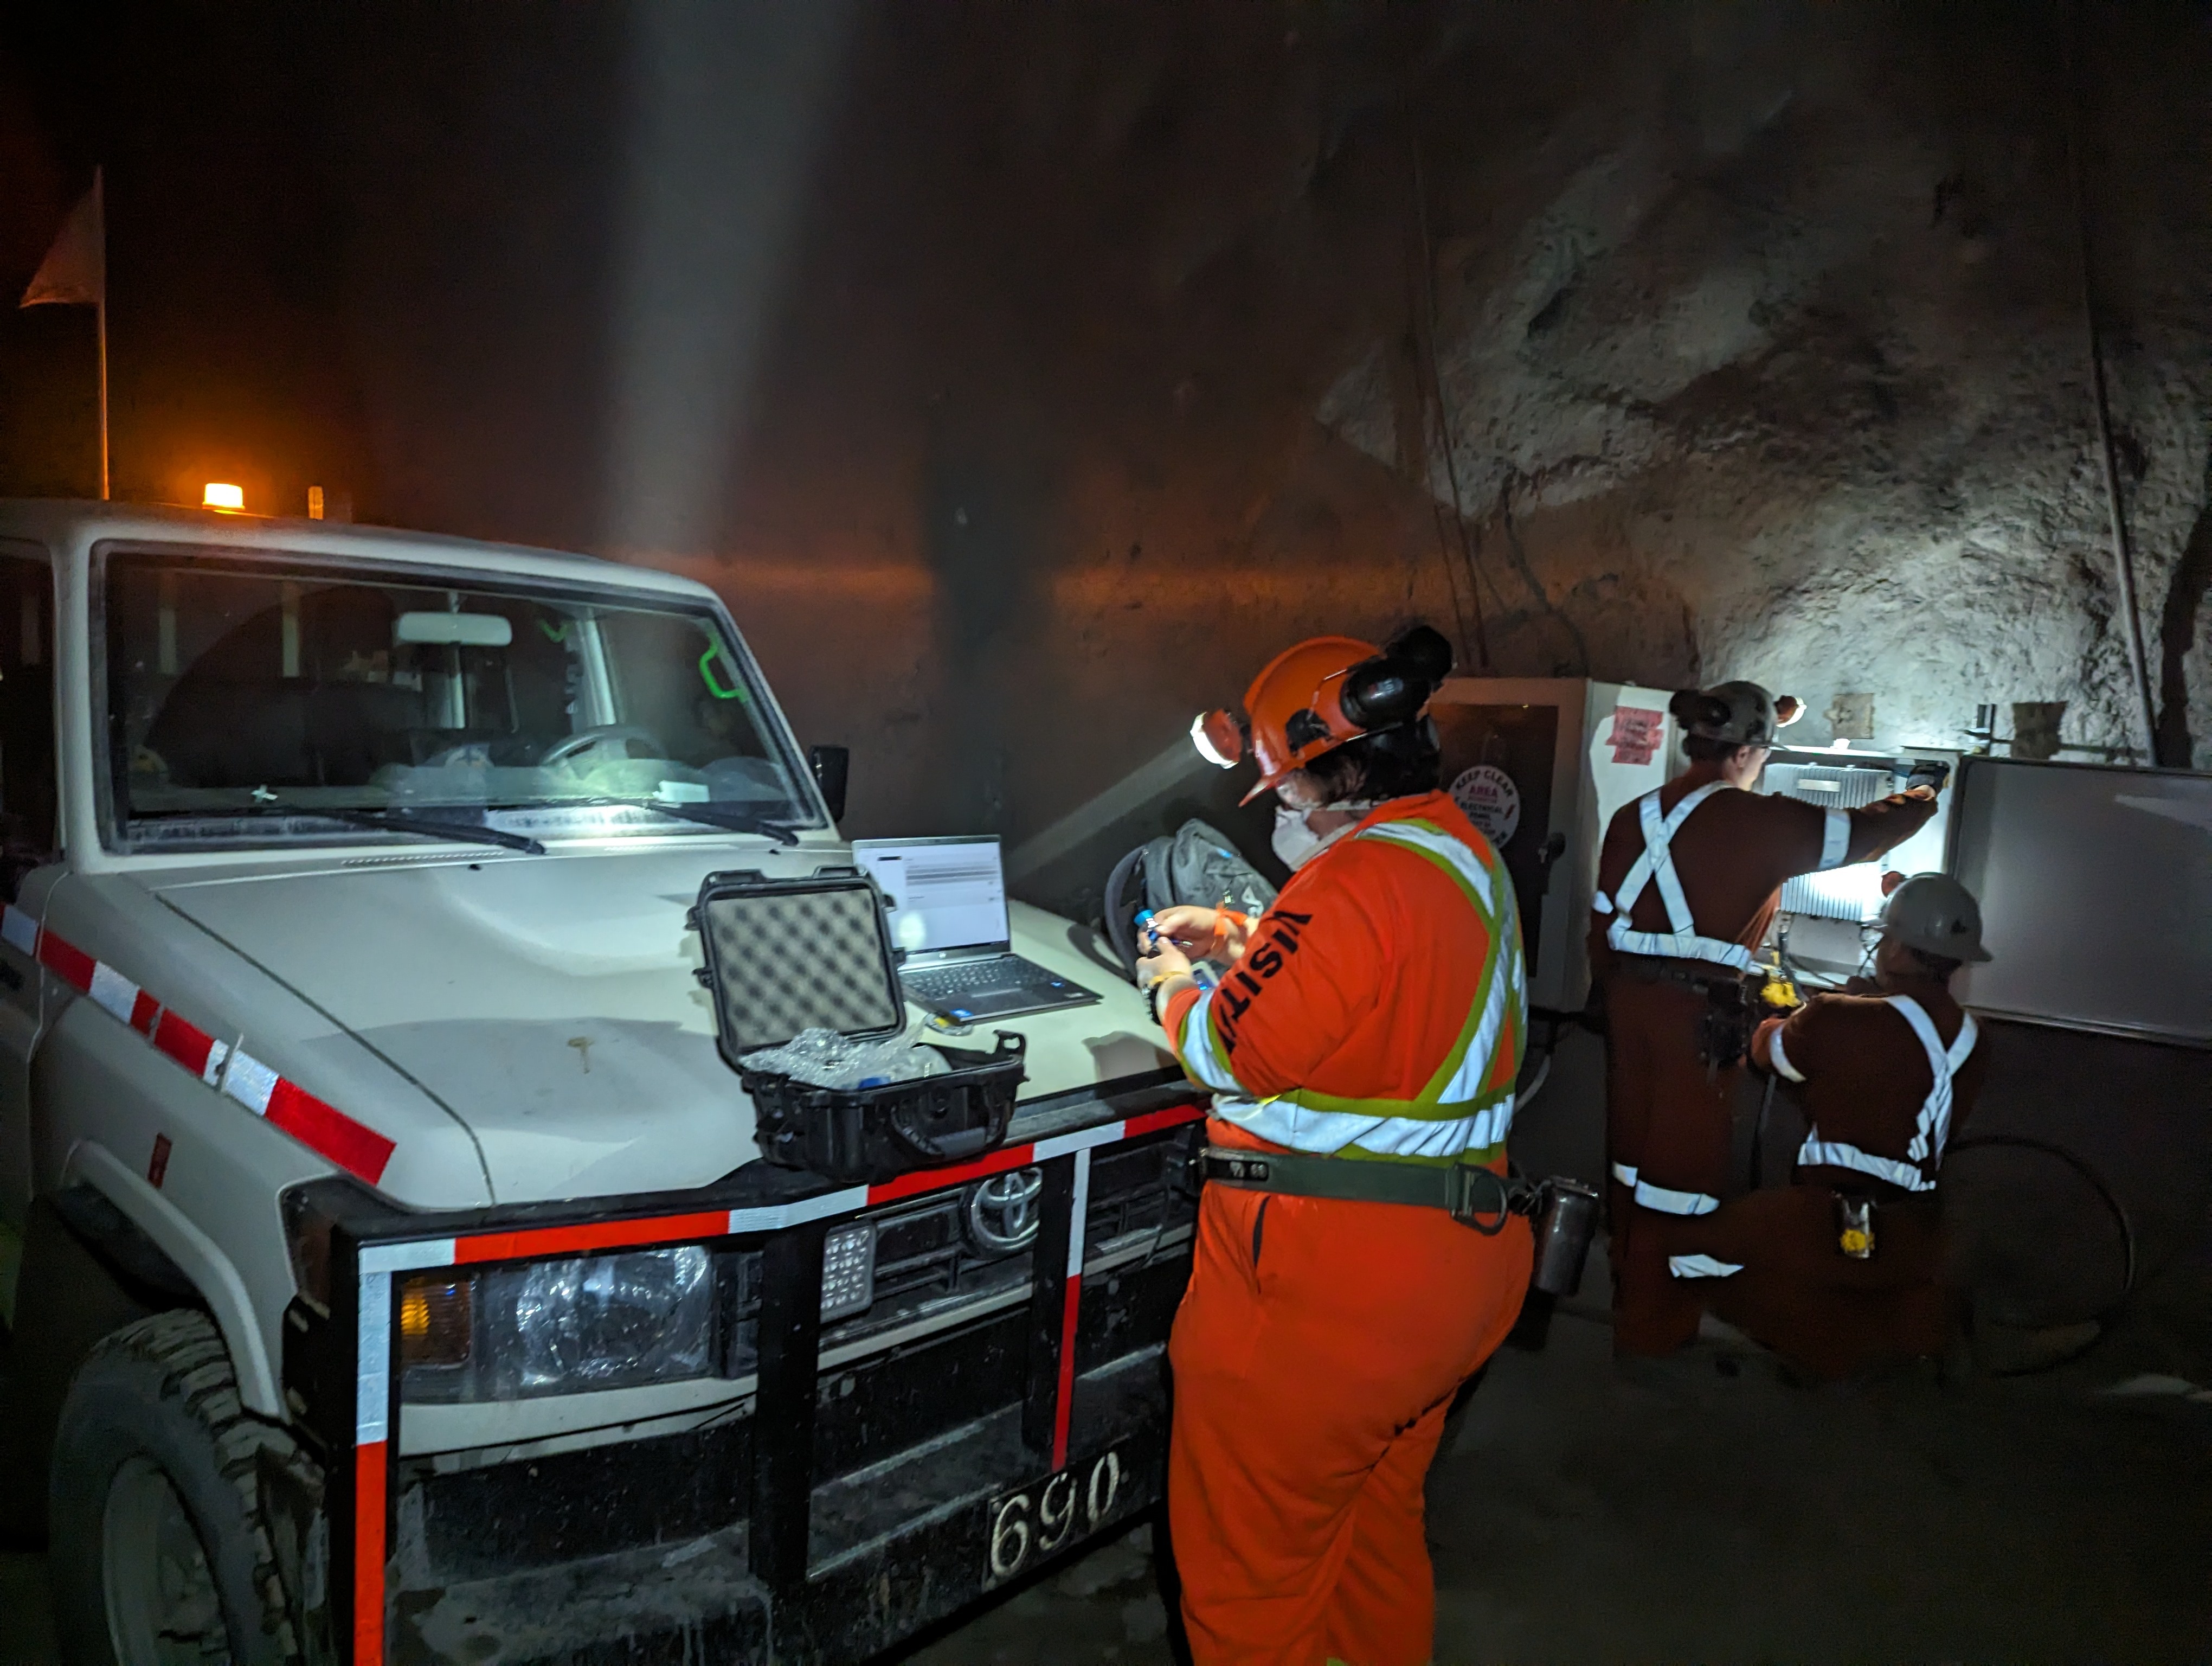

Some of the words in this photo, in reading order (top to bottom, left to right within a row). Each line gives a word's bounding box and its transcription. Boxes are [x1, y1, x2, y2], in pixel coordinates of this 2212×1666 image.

[1456, 770, 1481, 789] KEEP
[1484, 769, 1514, 797] CLEAR
[1469, 785, 1497, 796] AREA
[991, 1451, 1120, 1577] 690
